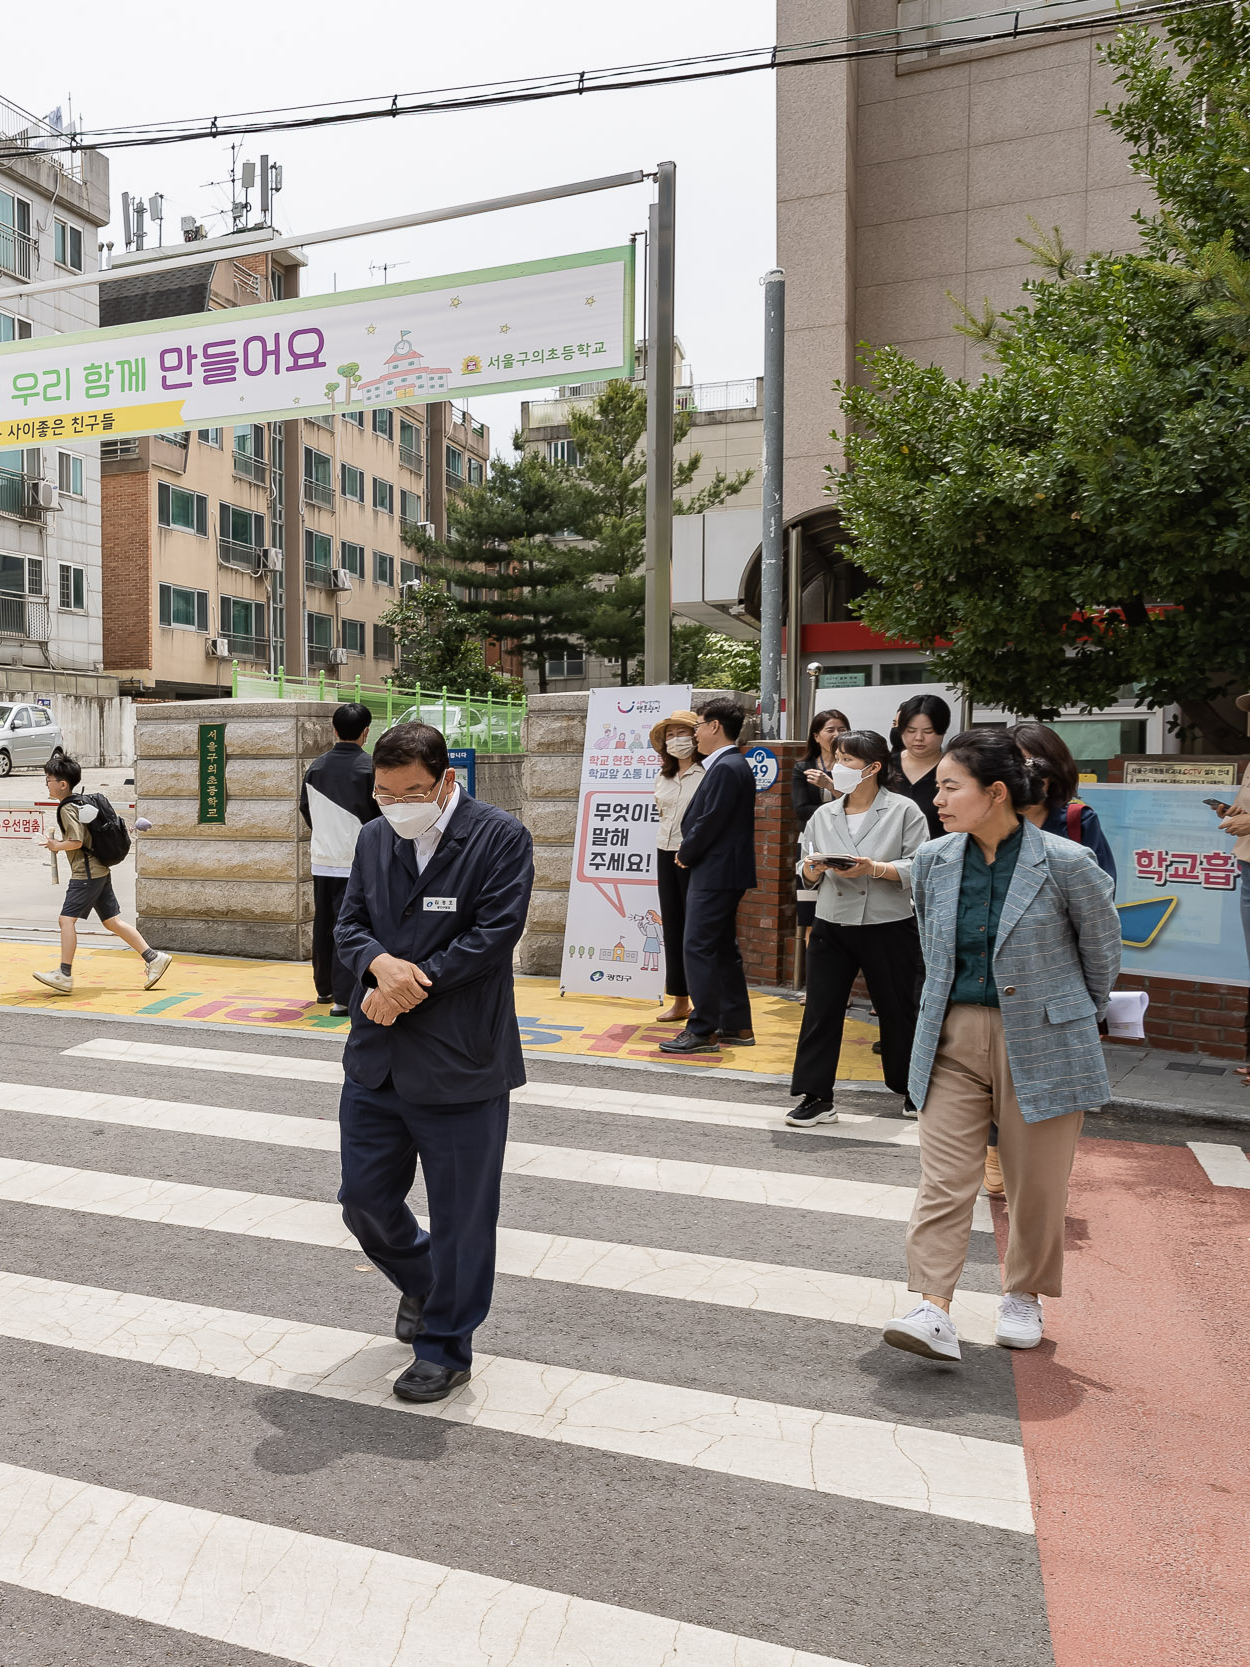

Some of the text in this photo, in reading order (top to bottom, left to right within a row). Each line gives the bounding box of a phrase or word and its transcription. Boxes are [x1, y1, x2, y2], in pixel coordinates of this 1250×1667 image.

[487, 341, 607, 370] 서울구의초등학교
[11, 367, 71, 406] 우리
[83, 357, 146, 399] 함께
[159, 327, 327, 391] 만들어요
[7, 418, 66, 440] 사이좋은
[71, 412, 116, 433] 친구들
[589, 755, 609, 766] 학교
[612, 755, 633, 766] 현장
[206, 729, 218, 817] 서울구의초등학교
[589, 768, 619, 779] 학교앞
[622, 768, 642, 779] 소통
[1183, 768, 1203, 776] CCTV
[2, 818, 41, 833] 우선멈춤
[592, 827, 629, 847] 말해
[589, 852, 652, 873] 주세요!
[1134, 849, 1242, 887] 학교흡
[606, 973, 632, 982] 광진구
